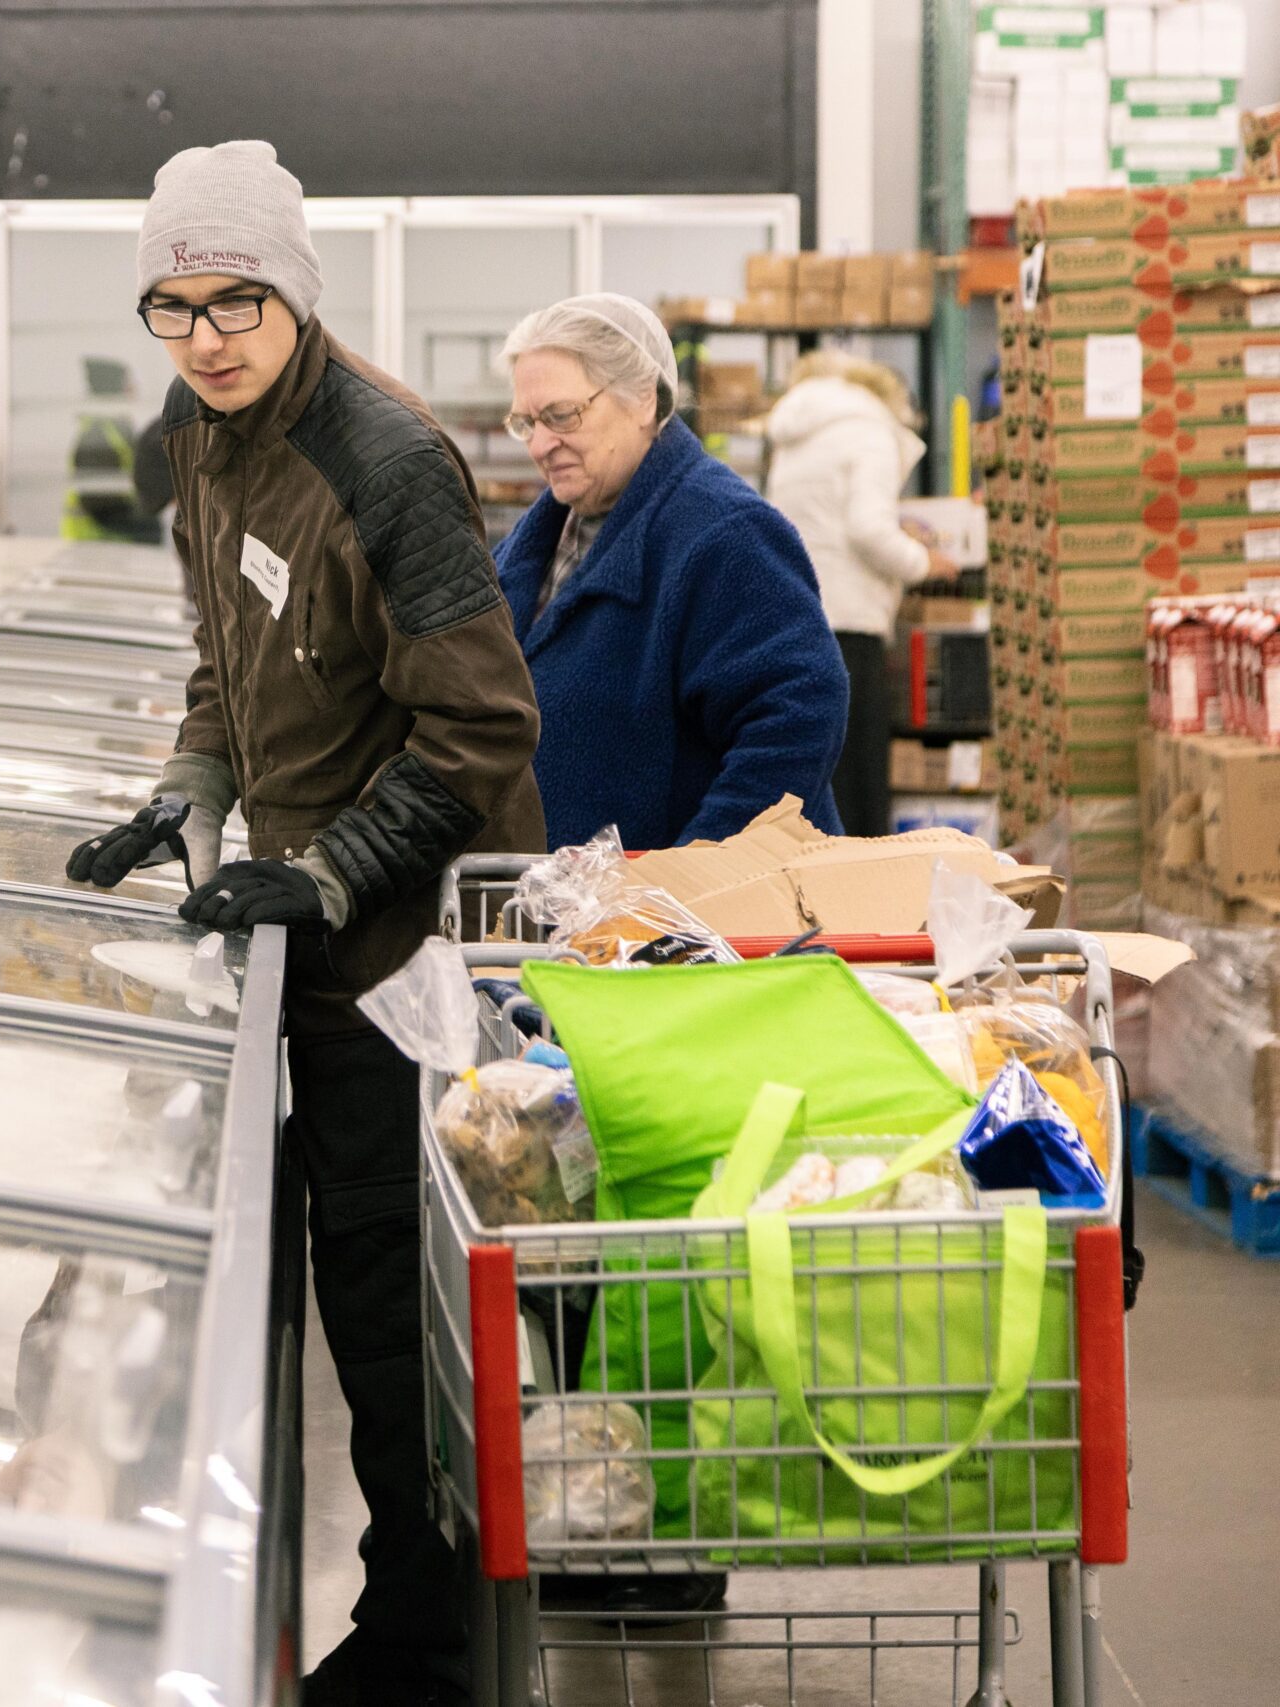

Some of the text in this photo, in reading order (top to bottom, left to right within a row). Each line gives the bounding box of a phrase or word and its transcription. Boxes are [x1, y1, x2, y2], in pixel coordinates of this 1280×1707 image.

[174, 247, 261, 267] KING PAINTING
[265, 557, 279, 578] Nick
